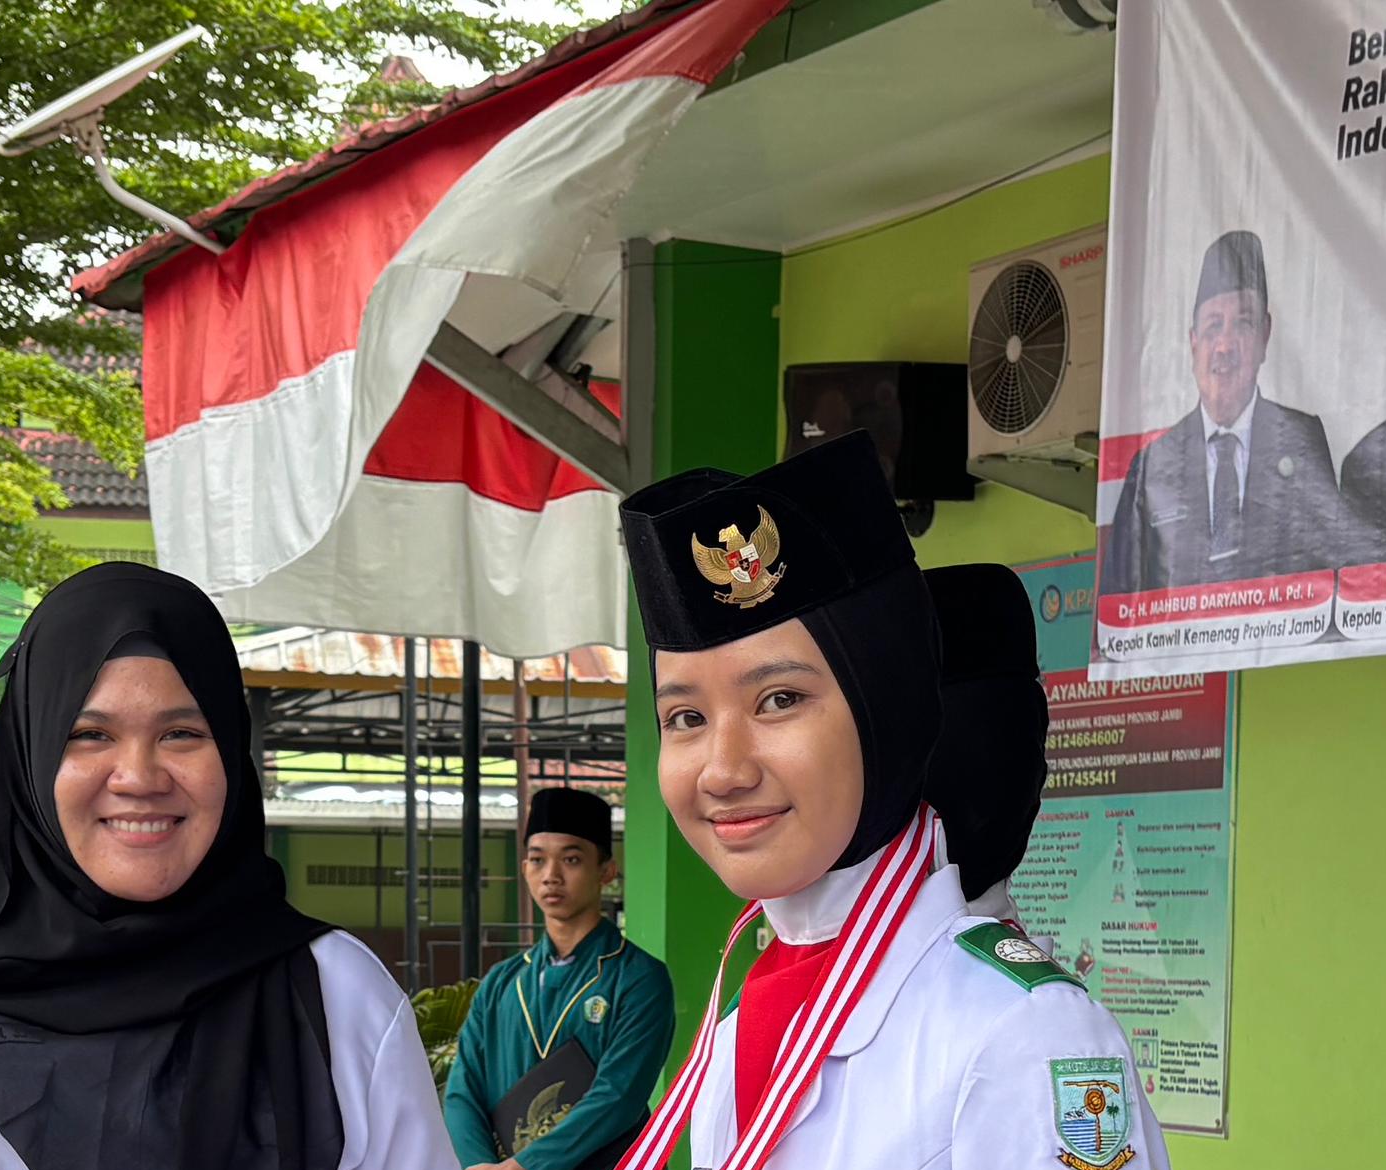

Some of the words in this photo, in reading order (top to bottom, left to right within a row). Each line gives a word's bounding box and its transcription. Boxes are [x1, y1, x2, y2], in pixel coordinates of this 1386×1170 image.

[1119, 604, 1136, 618] Dr.
[1138, 604, 1148, 617] H.
[1150, 597, 1197, 615] MAHBUB
[1200, 588, 1266, 610] DARYANTO,
[1269, 586, 1283, 603] M.
[1286, 584, 1303, 600] Pd.
[1342, 608, 1382, 632] Kepala
[1107, 635, 1144, 656] Kepala
[1146, 629, 1181, 648] Kanwil
[1184, 624, 1241, 648] Kemenag
[1243, 619, 1288, 641] Provinsi
[1288, 614, 1326, 637] Jambi
[1113, 673, 1205, 695] PENGADUAN
[1101, 922, 1126, 931] DASAR
[1128, 922, 1157, 931] HUKUM
